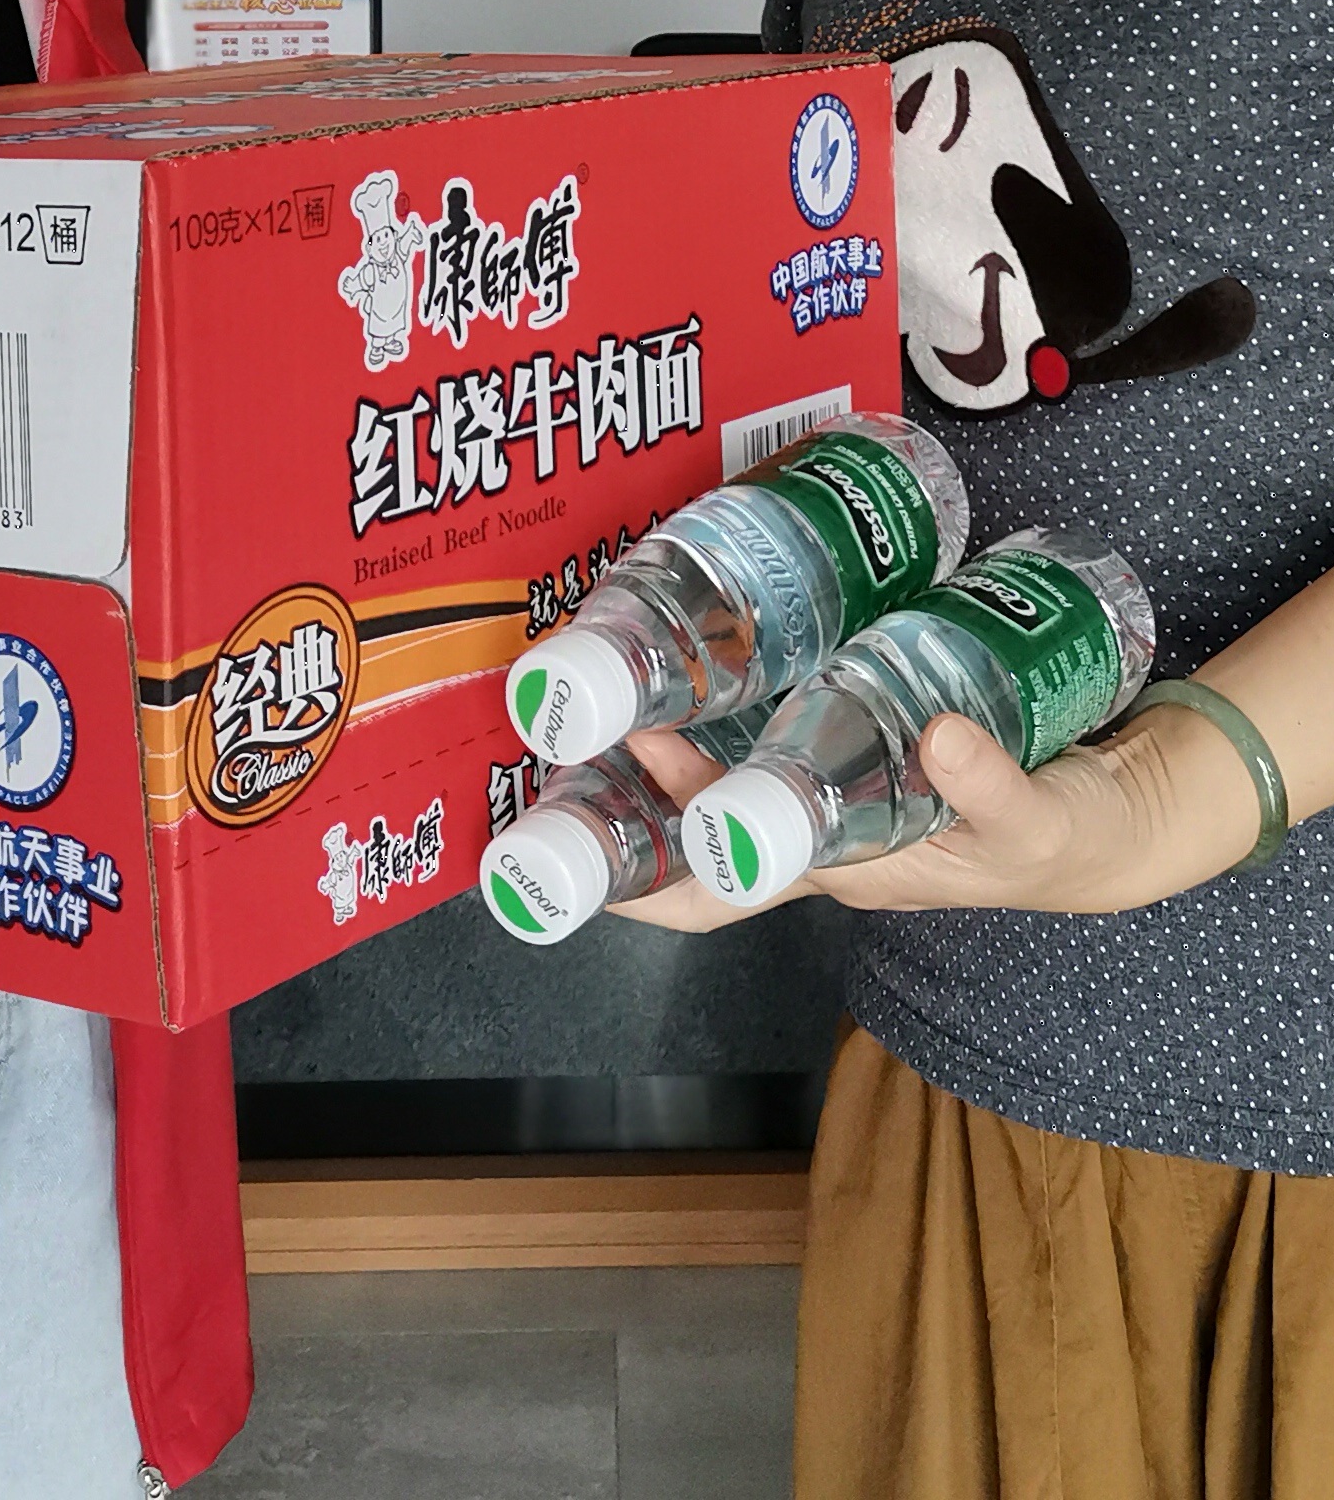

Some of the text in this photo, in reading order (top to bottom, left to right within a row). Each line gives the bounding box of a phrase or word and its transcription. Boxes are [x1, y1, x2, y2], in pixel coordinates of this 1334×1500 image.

[772, 239, 882, 297] 中国航天事业
[794, 280, 869, 329] 合作伙伴
[350, 314, 704, 535] 红烧牛肉面
[353, 496, 568, 584] Braised Beef Noodle
[212, 624, 346, 753] 经典
[544, 678, 573, 759] C'estbon
[488, 754, 551, 838] 红
[499, 852, 562, 919] C'estbon
[703, 810, 735, 894] C'estbon
